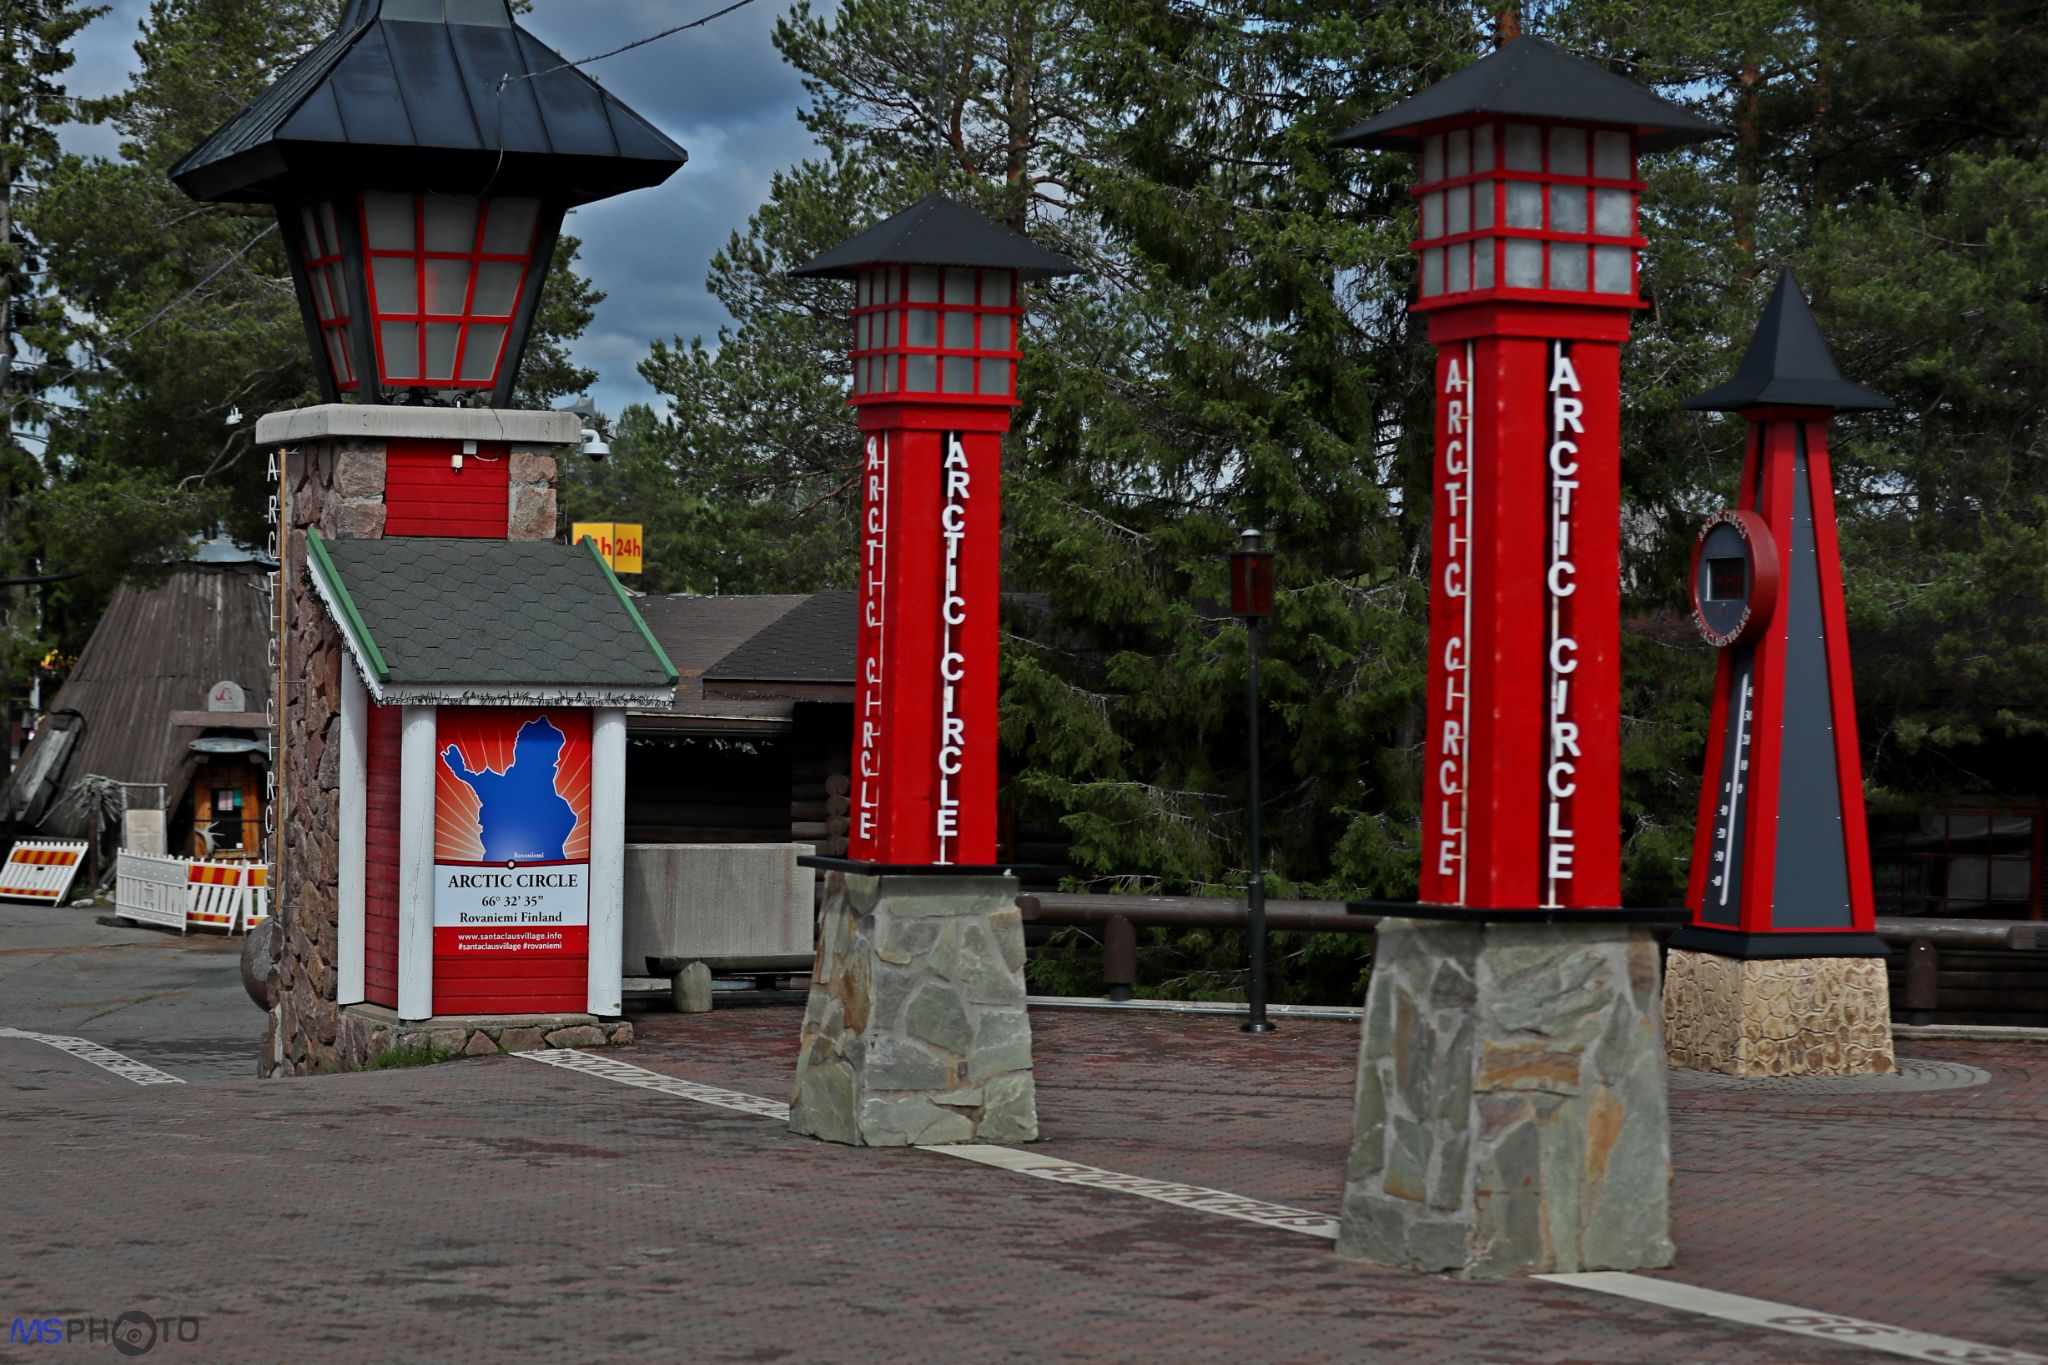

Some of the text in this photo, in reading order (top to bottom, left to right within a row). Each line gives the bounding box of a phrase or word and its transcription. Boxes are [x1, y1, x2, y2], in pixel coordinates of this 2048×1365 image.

[615, 538, 641, 557] 24h
[266, 452, 279, 667] ARCTIC
[1439, 359, 1463, 876] ARCTIC CIRCLE
[1547, 357, 1584, 879] ARCTIC CIRCLE
[860, 439, 881, 840] ARCTIC CIRCLE
[936, 441, 970, 837] ARCTIC CIRCLE
[514, 851, 544, 859] Rovaniemi
[448, 874, 578, 888] ARCTIC CIRCLE
[481, 896, 501, 907] 66°
[504, 896, 521, 907] 32’
[460, 911, 562, 923] Rovaniemi Finland
[458, 932, 562, 941] www.santaclausvillage.info
[458, 942, 562, 951] #santaclausvillage #rovaniemi
